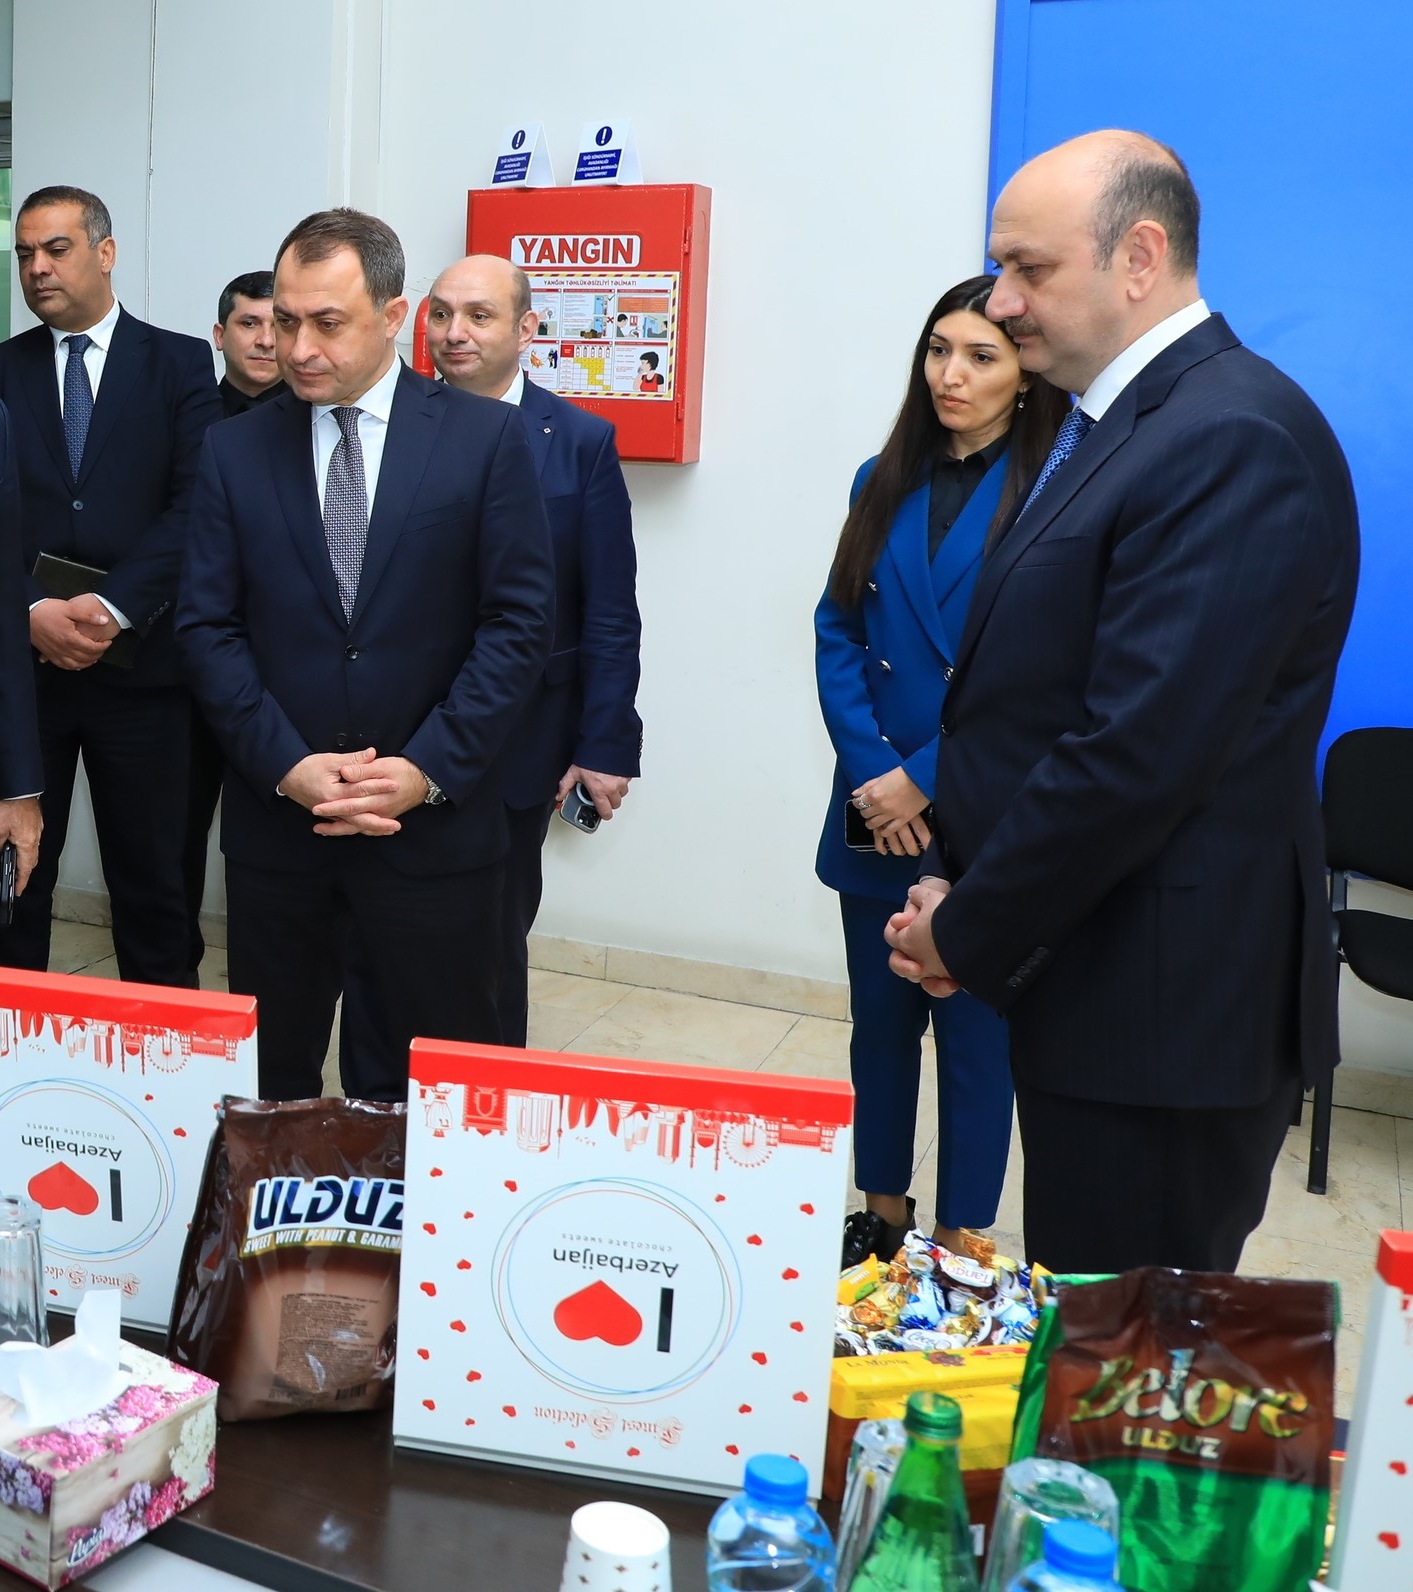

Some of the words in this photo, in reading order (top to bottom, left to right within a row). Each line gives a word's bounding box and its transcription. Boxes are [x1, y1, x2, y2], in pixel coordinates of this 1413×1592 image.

[518, 237, 634, 264] YANGIN
[21, 1135, 122, 1162] Azerbaijan
[243, 1234, 272, 1253] SWEET
[275, 1229, 302, 1245] WITH
[306, 1229, 346, 1243] PEANUT
[347, 1230, 356, 1244] &
[360, 1232, 403, 1249] CARAM
[553, 1248, 679, 1278] Azerbaijan
[1069, 1348, 1308, 1438] Belore
[1121, 1425, 1222, 1460] ULDUZ
[66, 1526, 106, 1567] Papia
